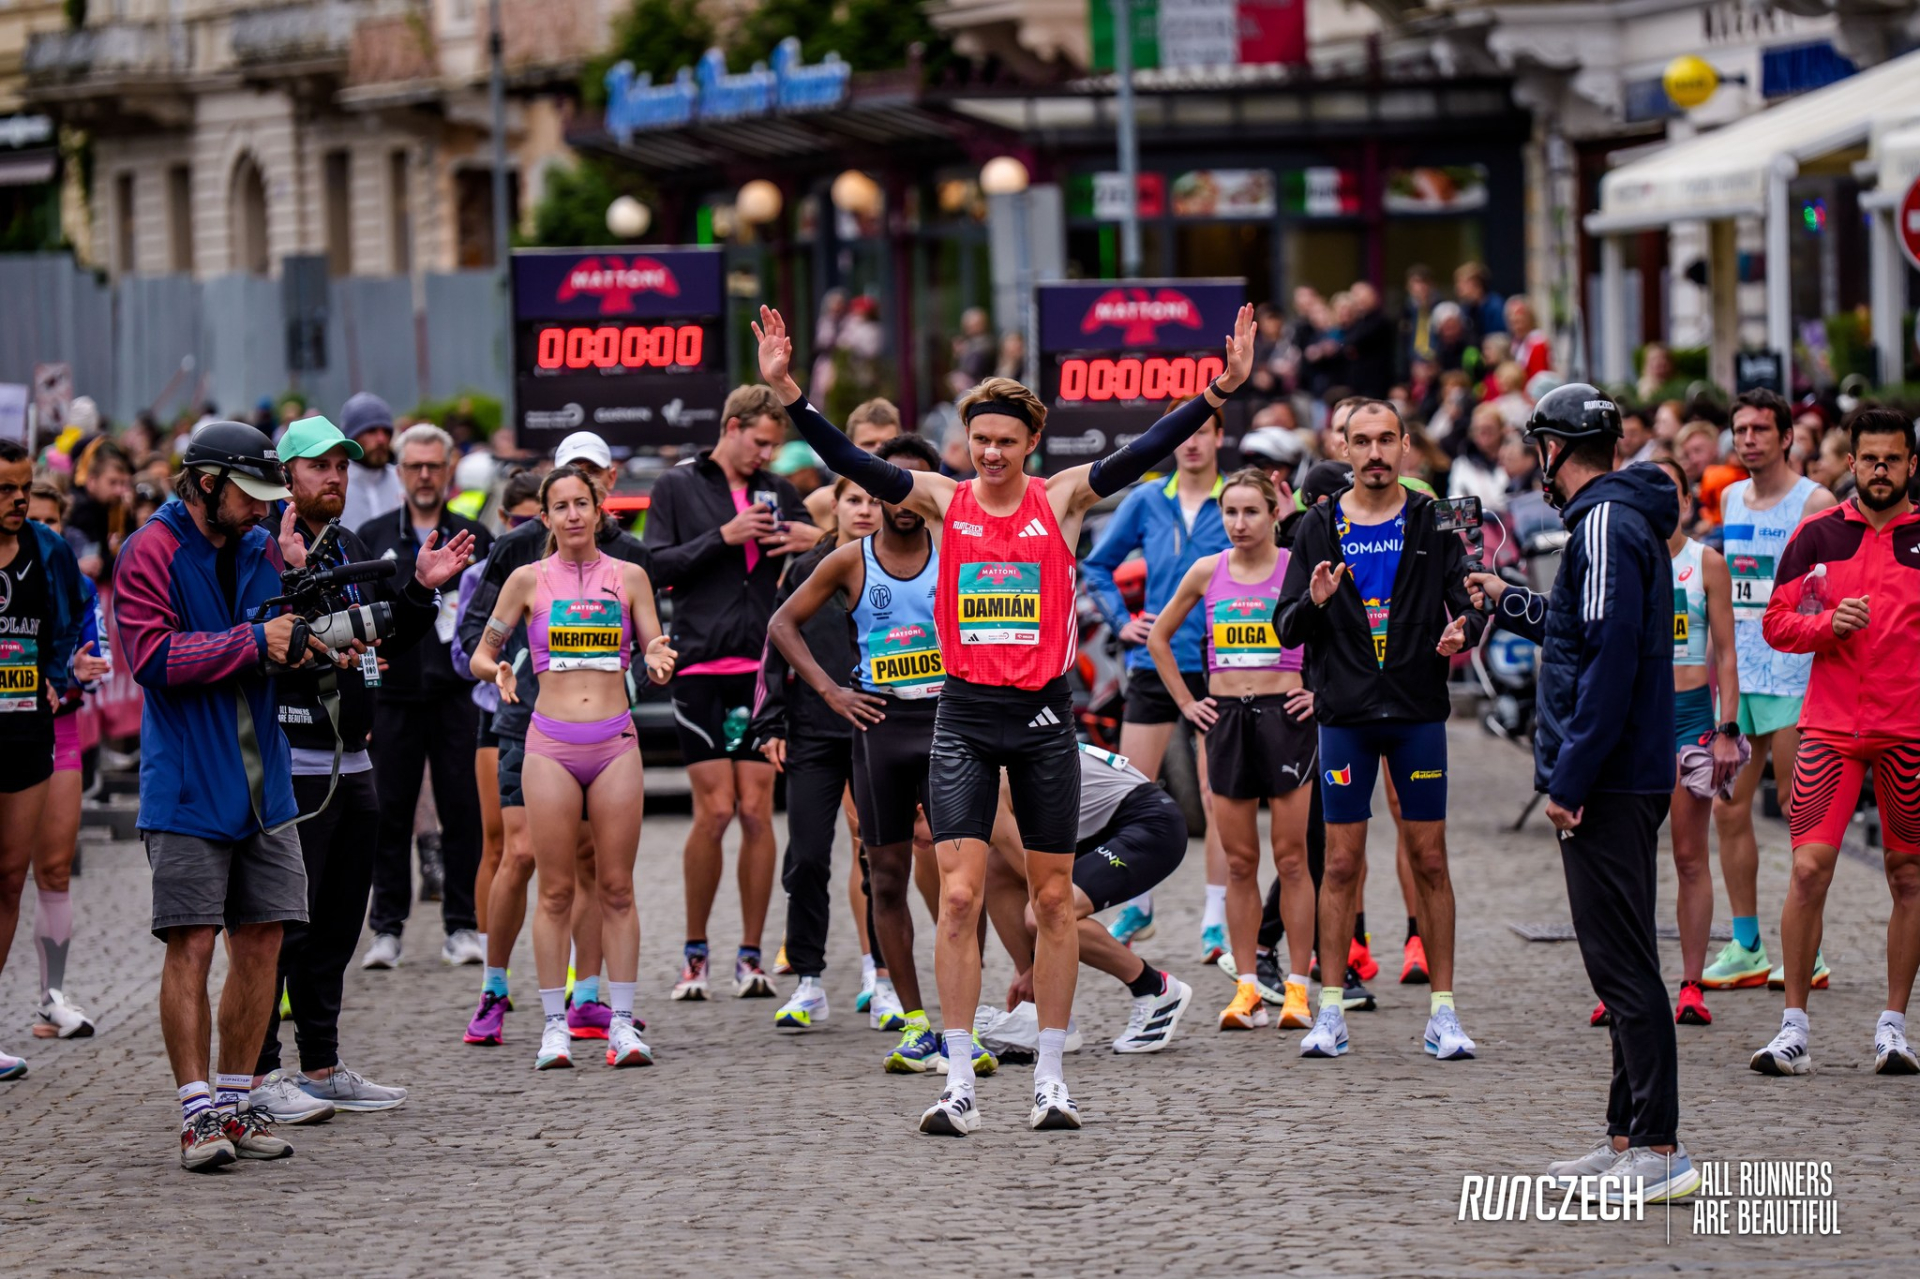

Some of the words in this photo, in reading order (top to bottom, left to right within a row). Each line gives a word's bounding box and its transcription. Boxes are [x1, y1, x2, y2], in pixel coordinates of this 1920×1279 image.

[571, 270, 666, 288] MATTONI
[1095, 302, 1188, 320] MATTONI
[538, 326, 703, 368] 00:00:00
[1736, 581, 1751, 600] 14
[963, 594, 1035, 618] DAMIÁN
[551, 632, 619, 647] MERITXELL
[889, 629, 921, 639] MATTONI
[1227, 626, 1267, 645] OLGA
[875, 653, 942, 680] PAULOS
